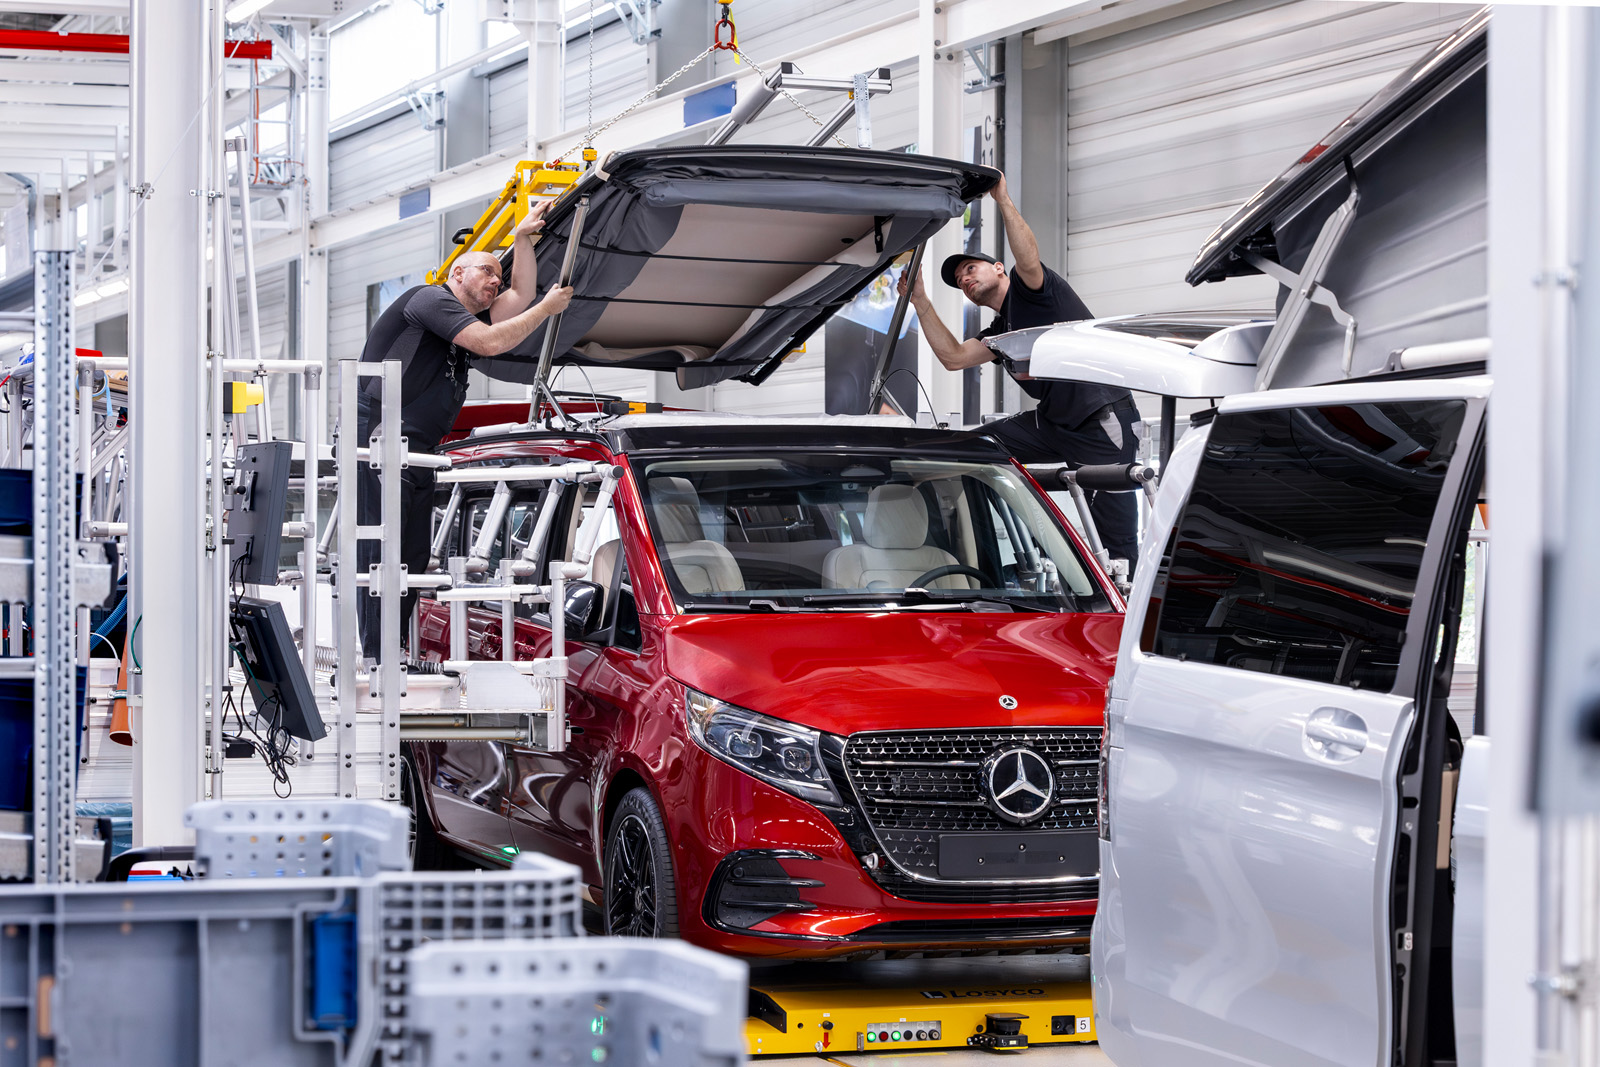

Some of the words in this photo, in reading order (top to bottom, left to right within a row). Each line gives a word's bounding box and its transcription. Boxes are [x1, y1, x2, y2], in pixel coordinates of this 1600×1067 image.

[985, 115, 991, 141] C
[949, 988, 1045, 998] LOSYCO
[1080, 1019, 1087, 1031] 5
